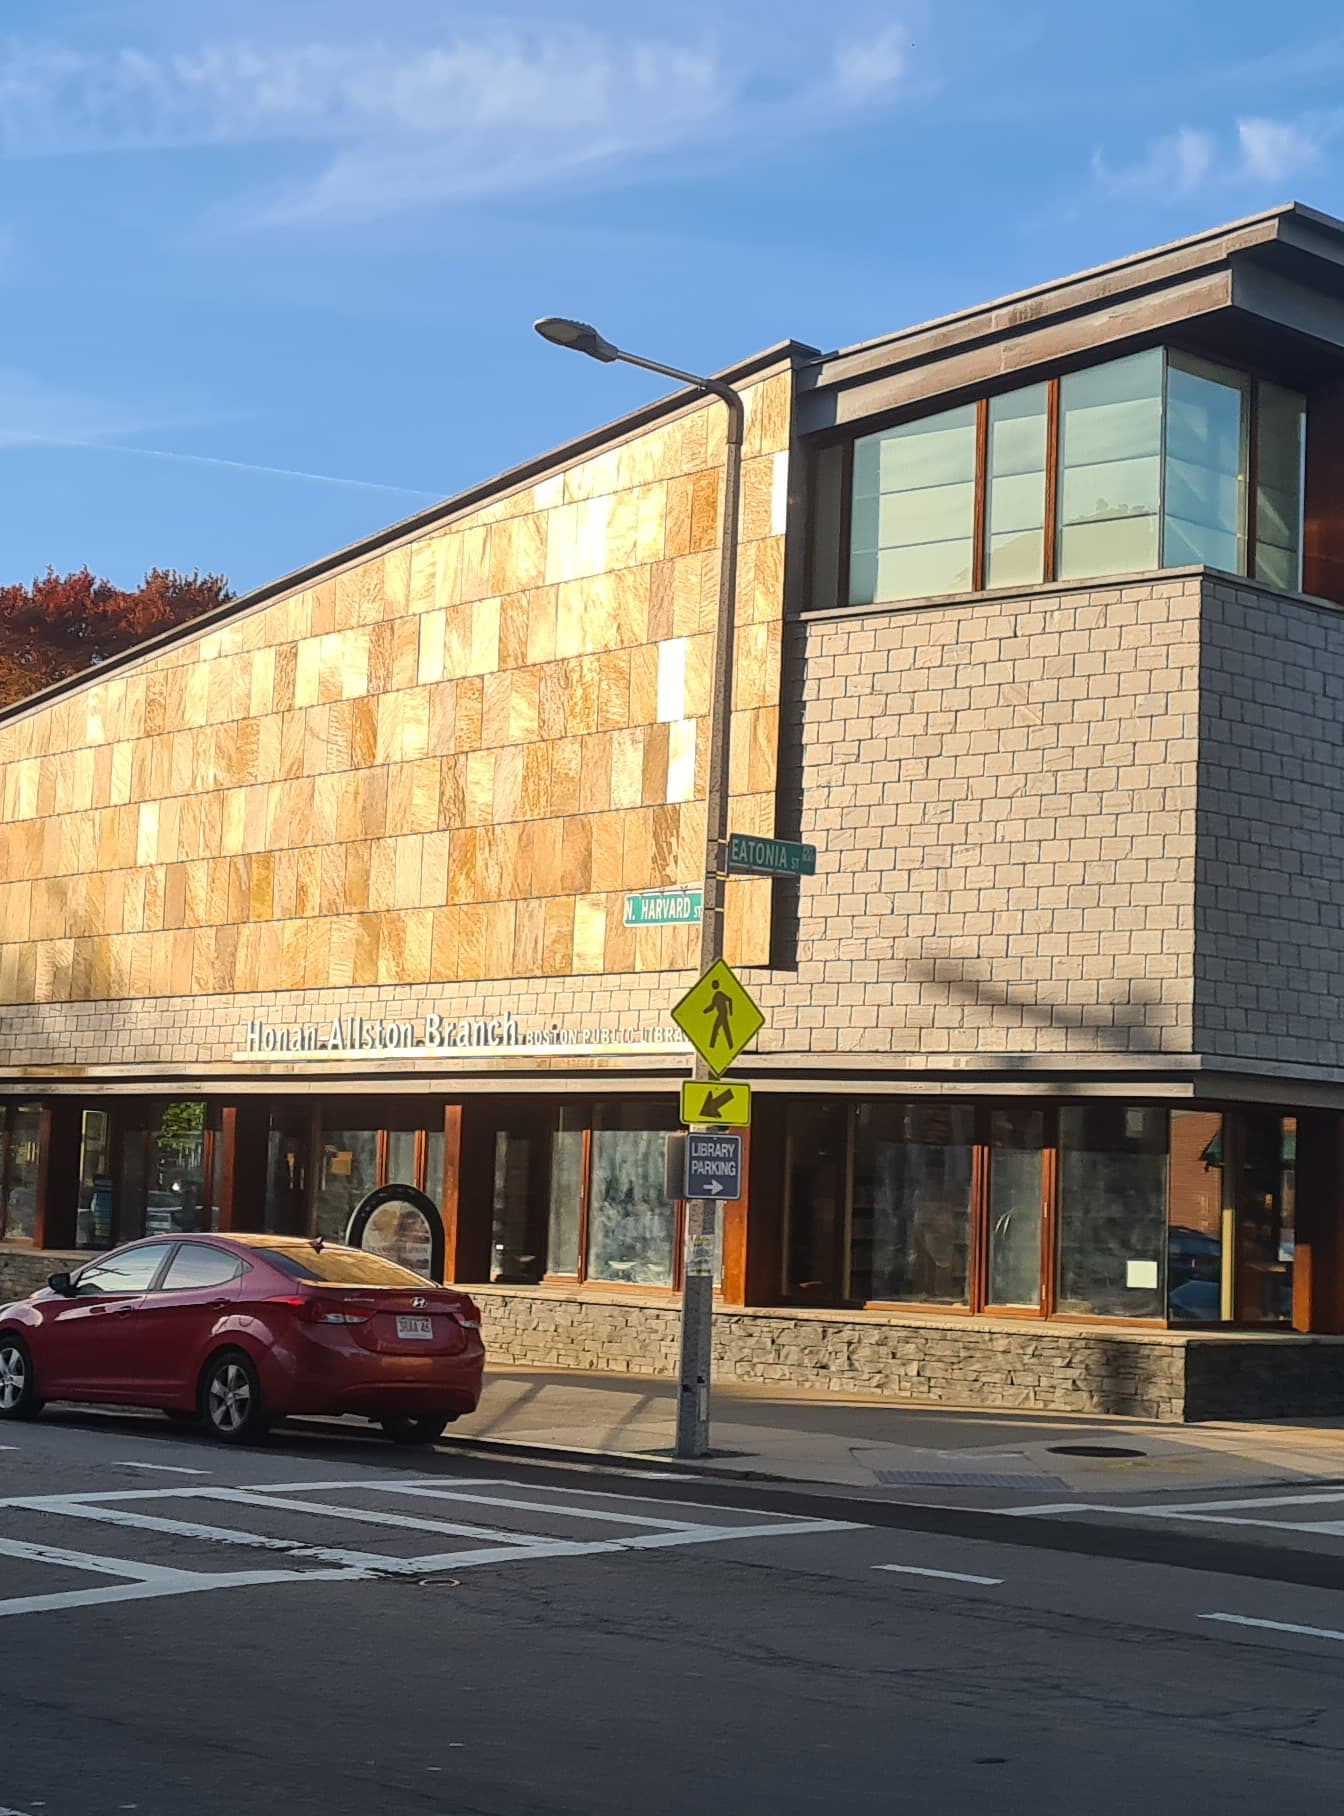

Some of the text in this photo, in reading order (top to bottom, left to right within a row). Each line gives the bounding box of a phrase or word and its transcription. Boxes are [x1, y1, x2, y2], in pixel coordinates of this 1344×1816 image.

[731, 838, 788, 868] EATONIA
[791, 857, 799, 870] ST
[640, 898, 691, 921] HARVARD
[247, 1012, 690, 1052] Honan-Allston Branch BOSTON PUBLIC LIBRA
[691, 1142, 736, 1158] LIBRARY
[691, 1160, 737, 1177] PARKING
